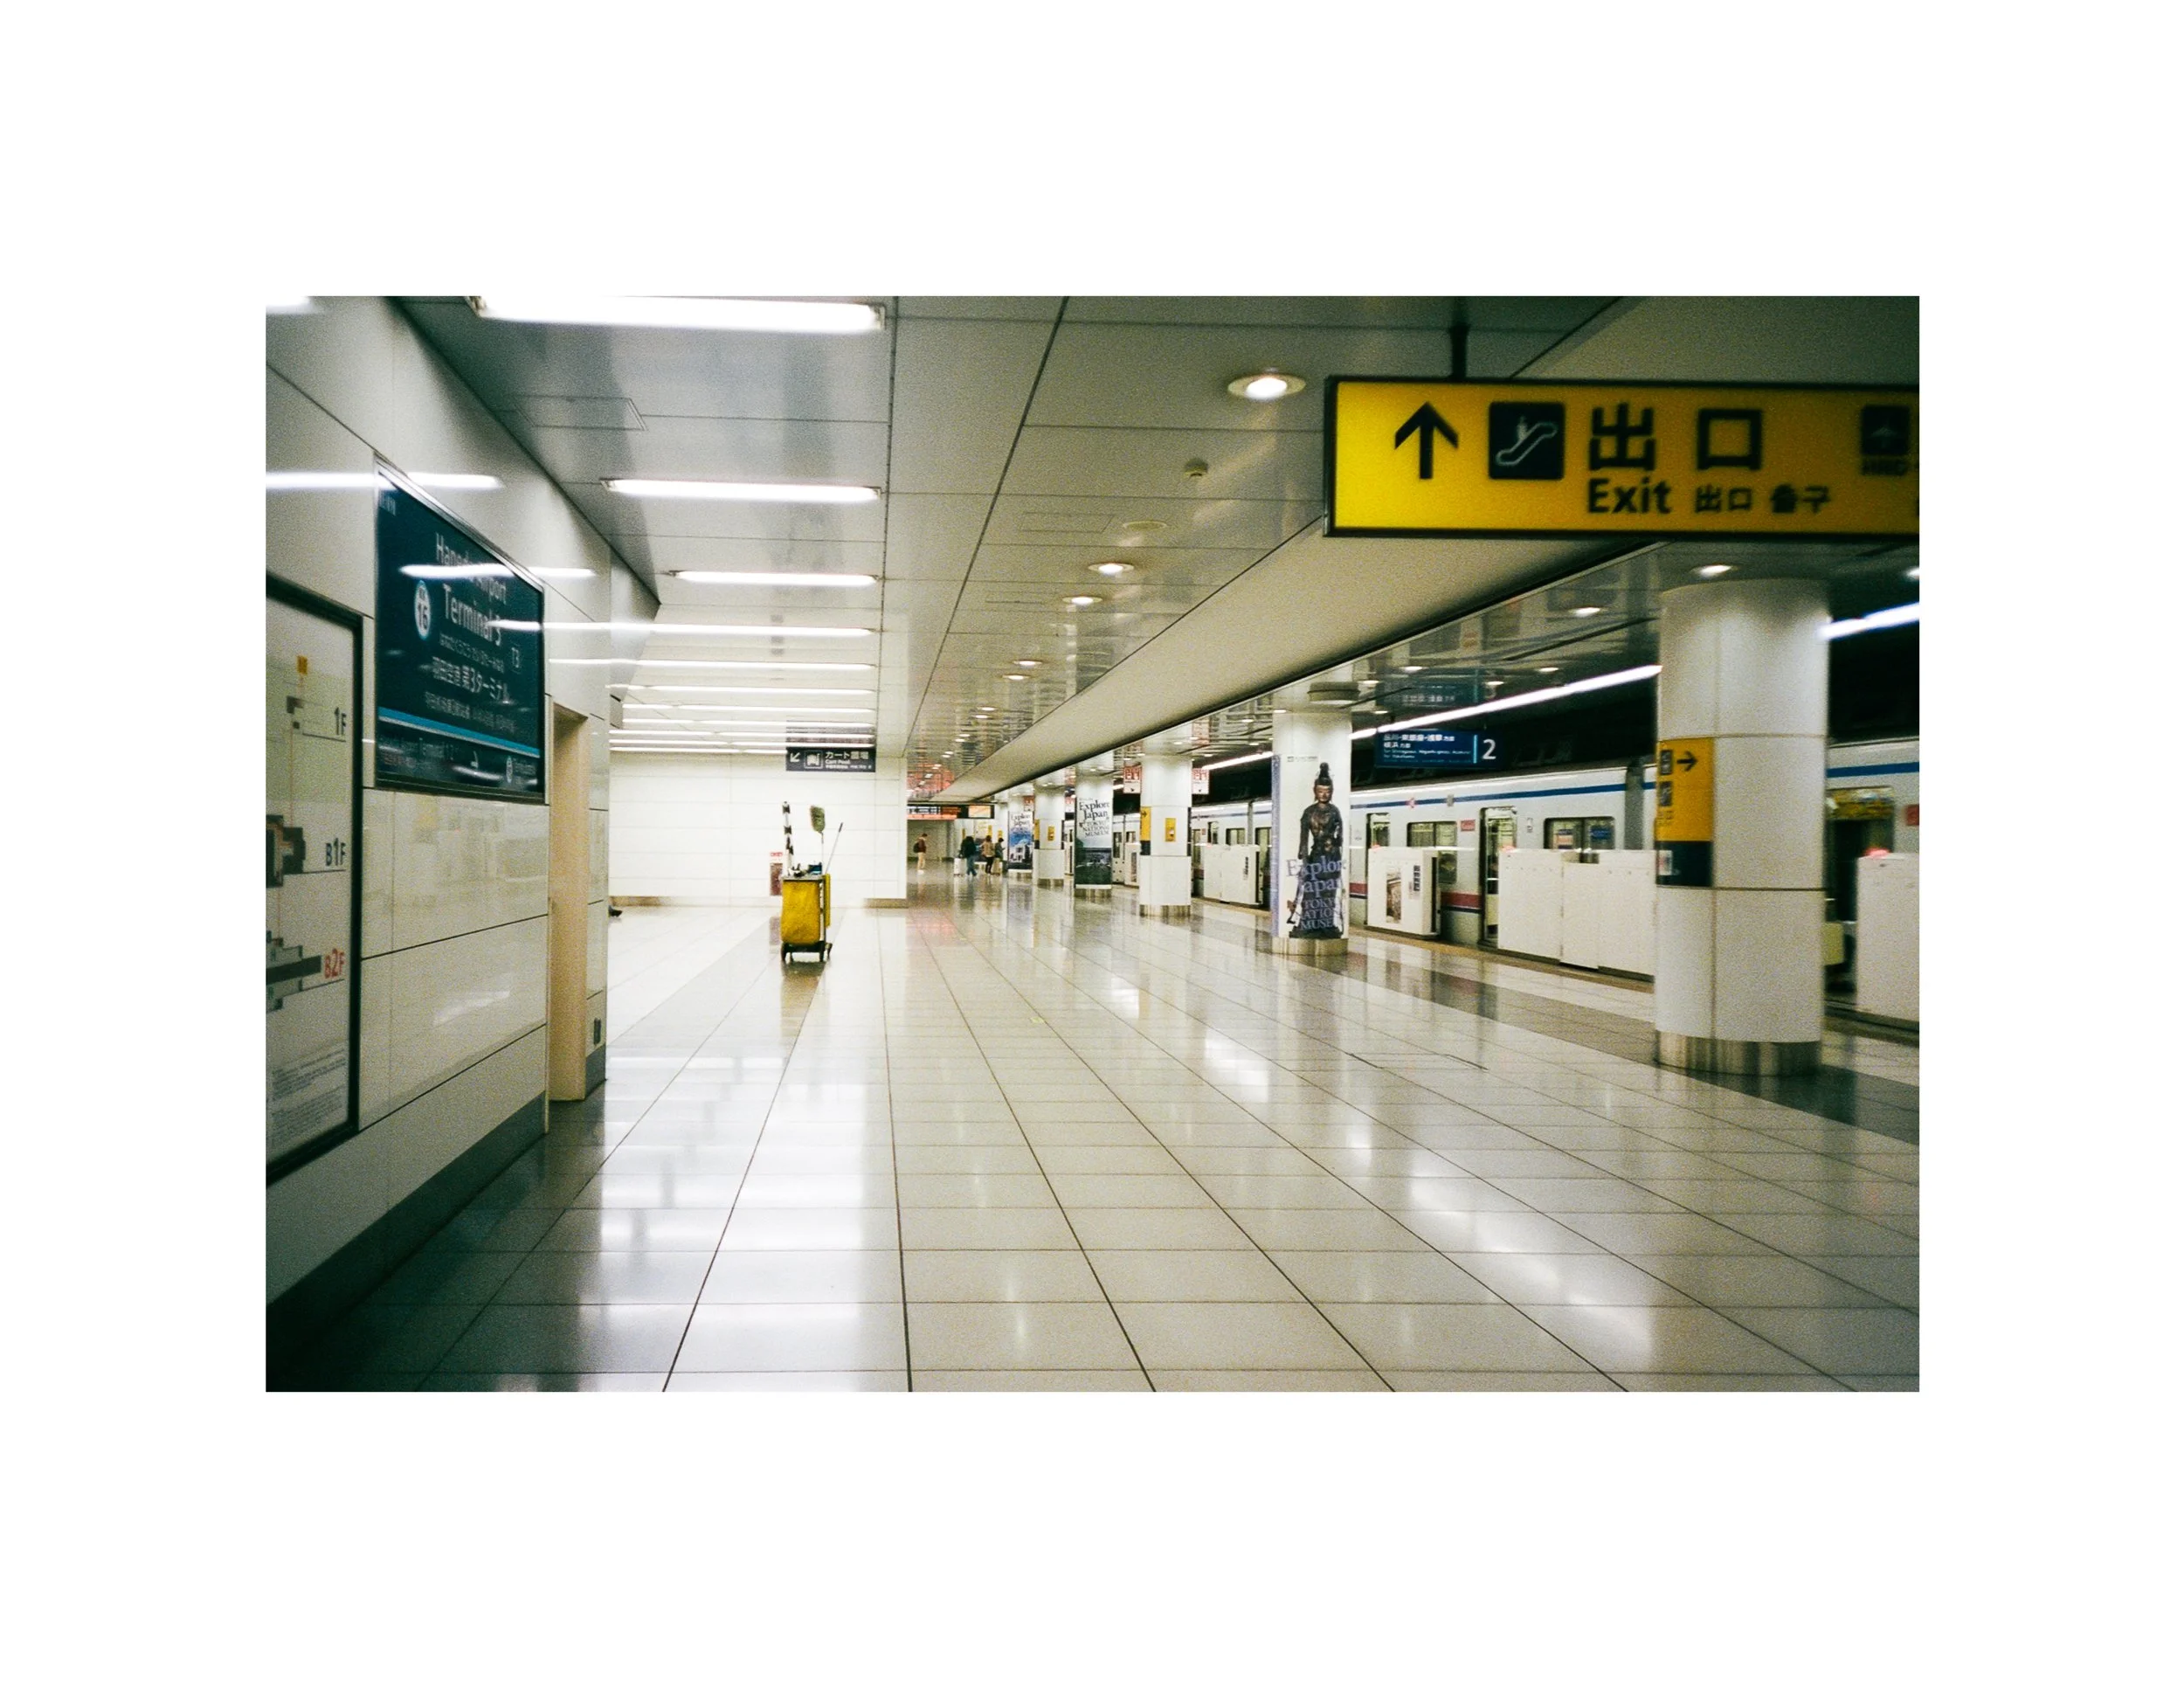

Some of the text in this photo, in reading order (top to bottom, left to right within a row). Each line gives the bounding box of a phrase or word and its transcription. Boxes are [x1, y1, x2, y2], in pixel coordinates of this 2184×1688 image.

[1588, 403, 1762, 470] 出口
[1588, 477, 1671, 514] Exit
[1695, 485, 1752, 513] 出口
[418, 602, 428, 631] 16
[443, 583, 493, 642] Terminal
[334, 707, 347, 736] 1F
[1482, 738, 1496, 760] 2
[1083, 809, 1109, 821] Japan
[325, 837, 346, 867] B1F
[1304, 898, 1337, 910] TOKY
[324, 947, 345, 979] B2F
